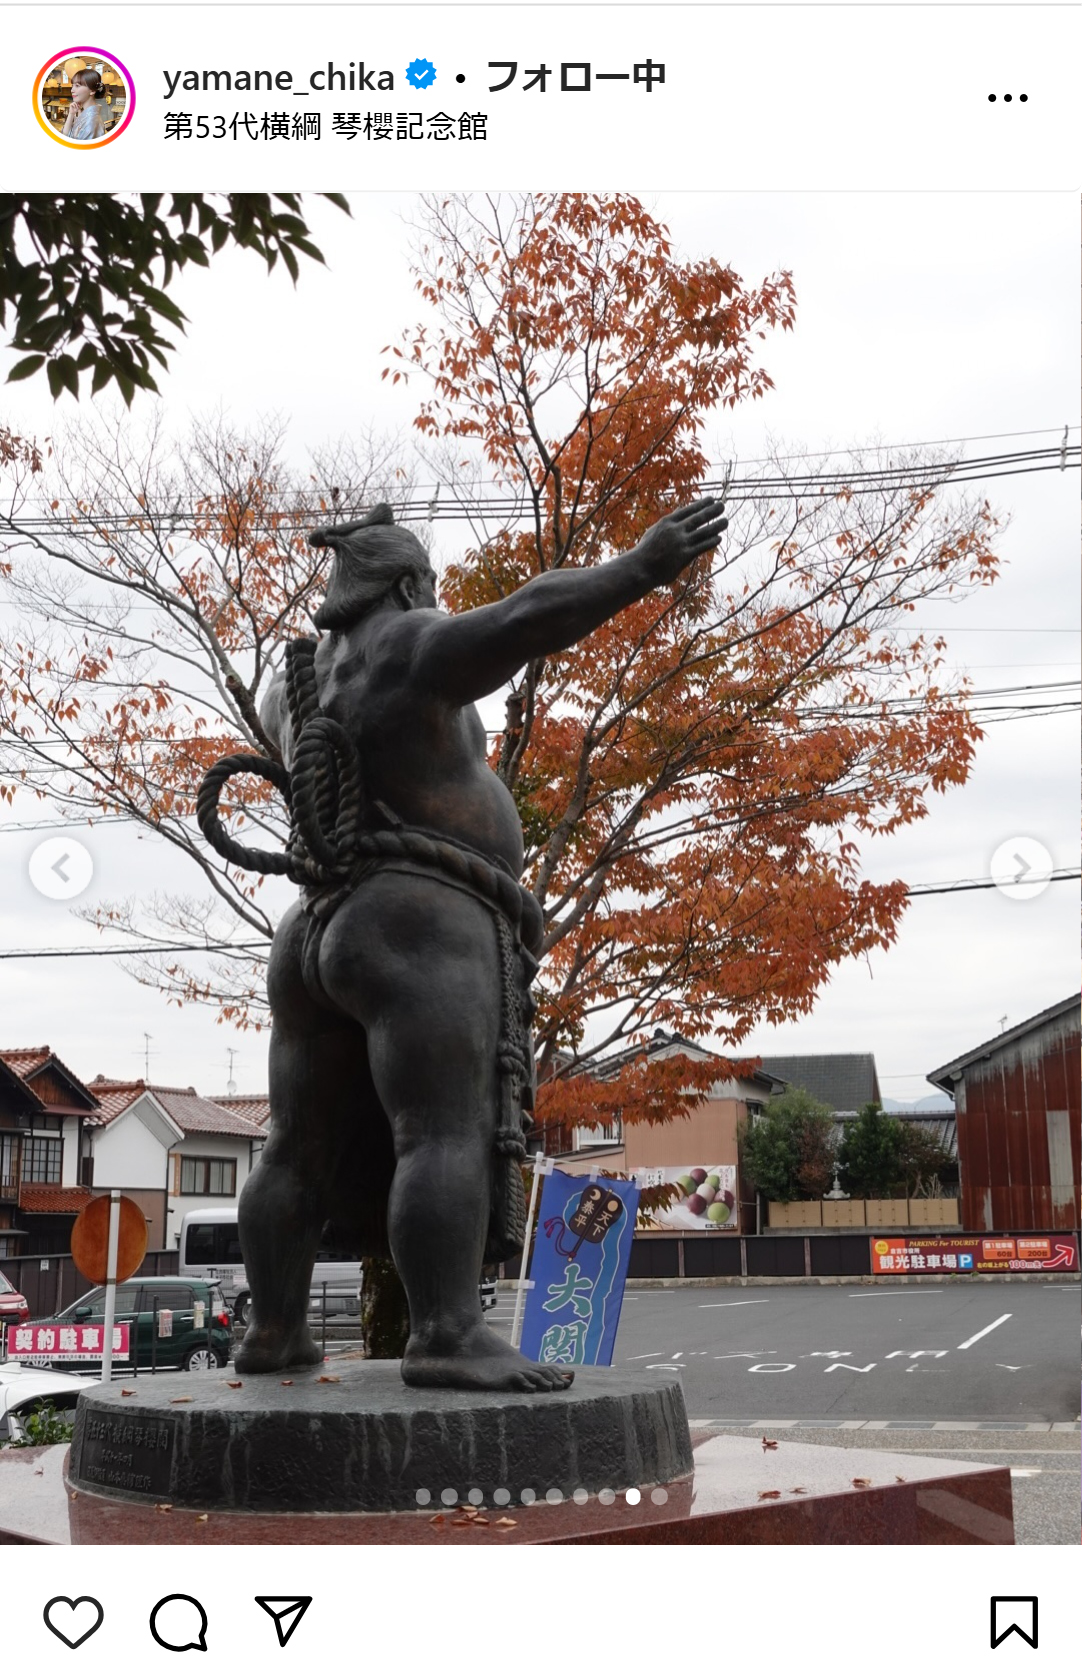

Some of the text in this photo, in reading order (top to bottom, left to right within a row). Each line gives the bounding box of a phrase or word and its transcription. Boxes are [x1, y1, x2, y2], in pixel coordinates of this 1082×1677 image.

[574, 1200, 595, 1228] 泰平
[593, 1212, 613, 1237] 天下
[879, 1254, 957, 1269] 観光駐車場
